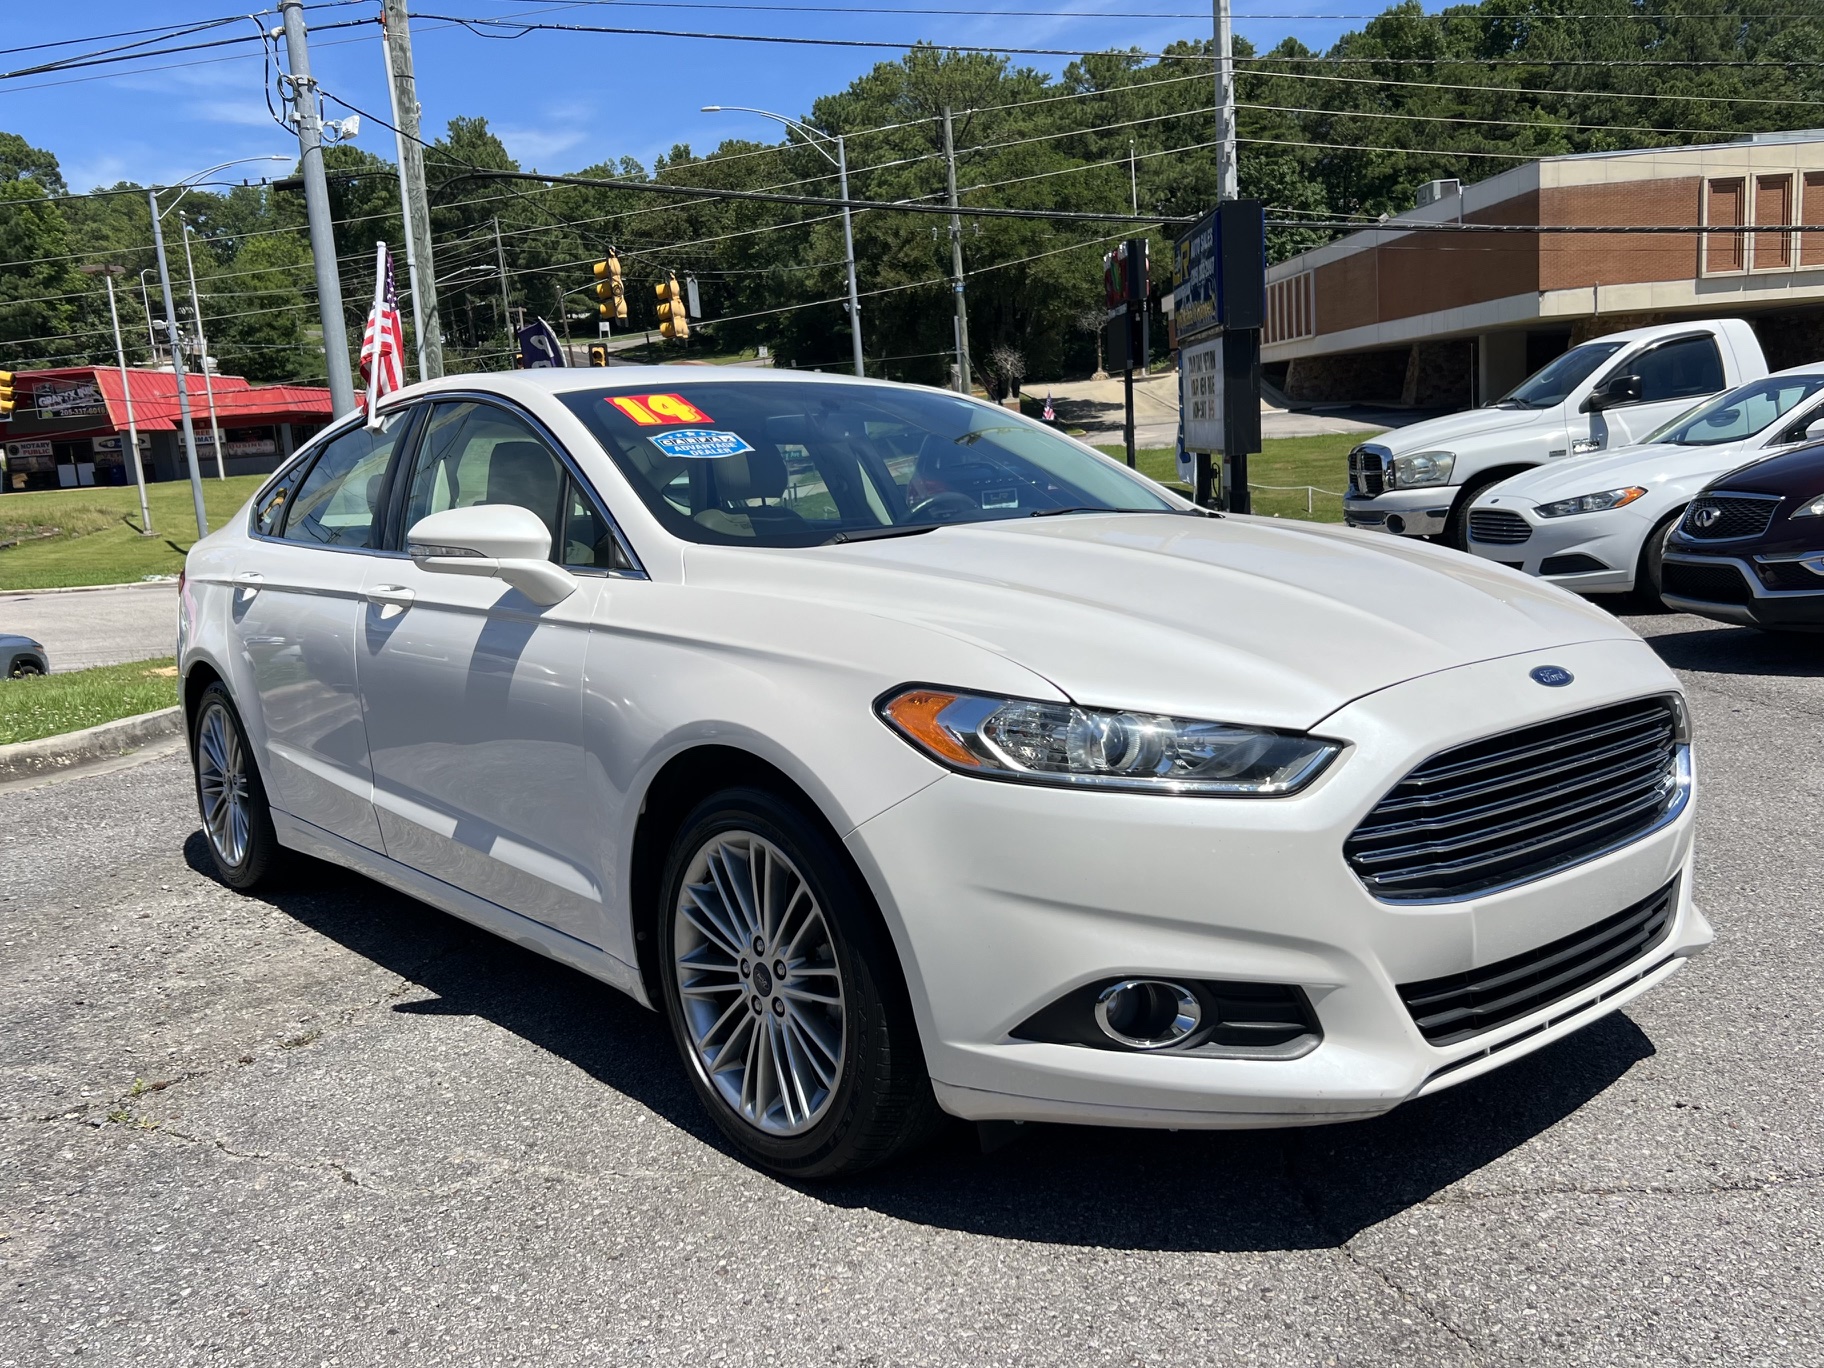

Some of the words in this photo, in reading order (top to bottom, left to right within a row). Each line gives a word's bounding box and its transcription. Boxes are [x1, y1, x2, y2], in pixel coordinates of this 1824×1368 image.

[613, 395, 702, 424] 14
[660, 435, 736, 446] CARFAX
[20, 442, 50, 450] NOTARY
[674, 442, 738, 452] ADVANTAGE
[691, 448, 733, 456] DEALER
